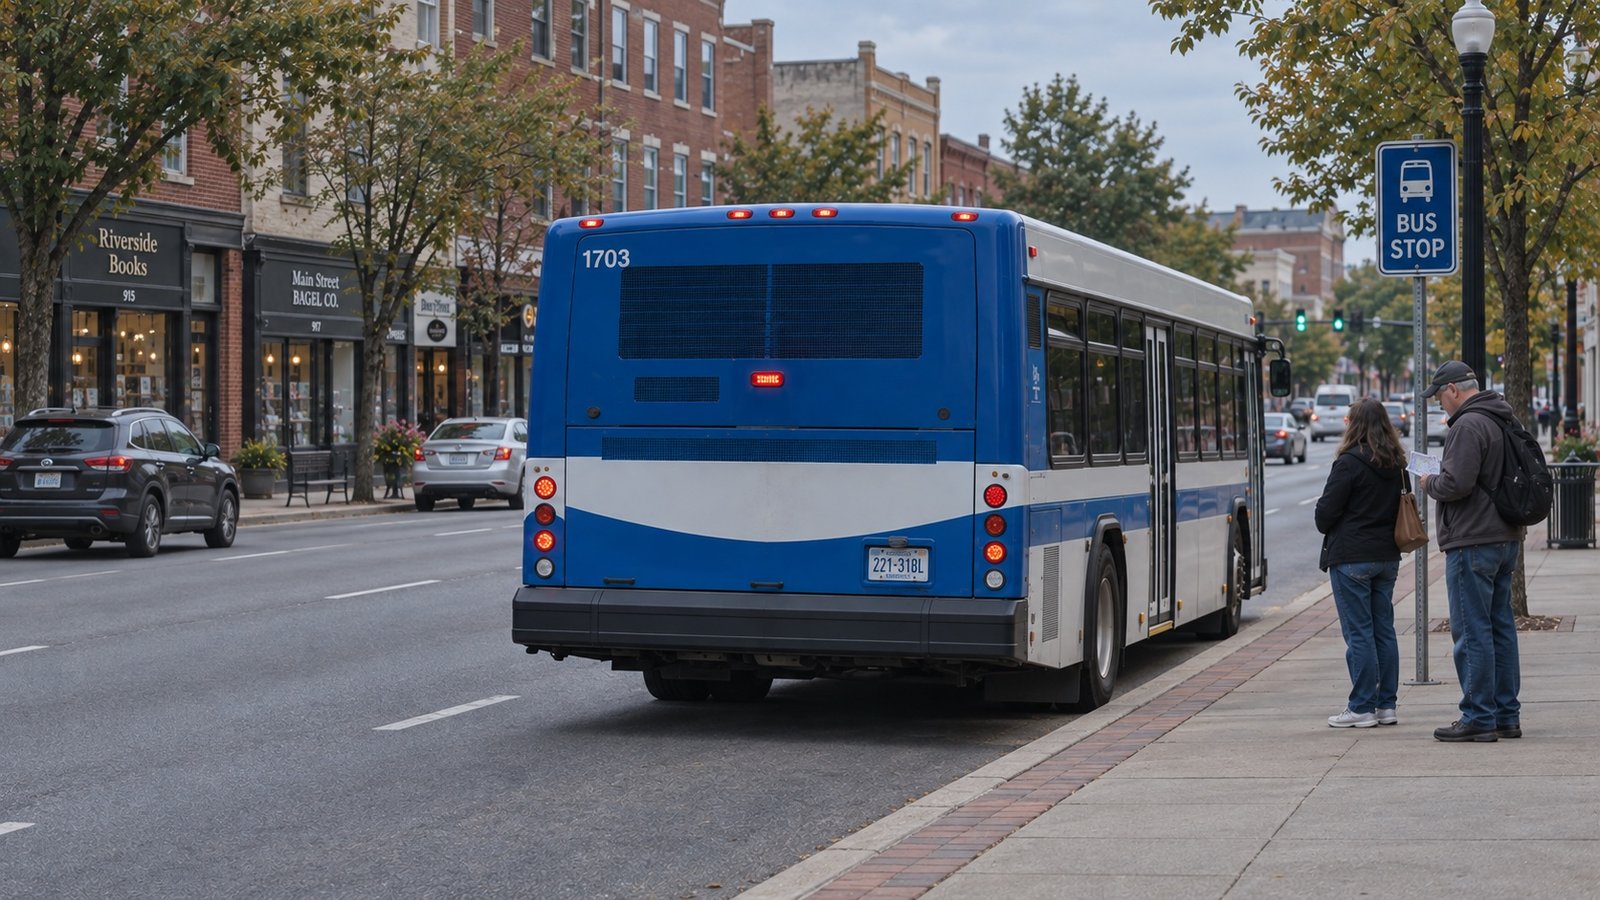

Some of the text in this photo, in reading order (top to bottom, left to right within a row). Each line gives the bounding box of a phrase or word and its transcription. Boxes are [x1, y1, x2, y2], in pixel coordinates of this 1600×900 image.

[1397, 212, 1437, 233] BUS
[98, 227, 158, 253] Riverside
[1390, 238, 1445, 259] STOP
[108, 253, 148, 276] Books
[582, 249, 630, 268] 1703
[292, 269, 340, 289] Main Street
[122, 289, 136, 302] 915
[292, 289, 339, 308] BAGEL CO.
[311, 321, 321, 332] 917
